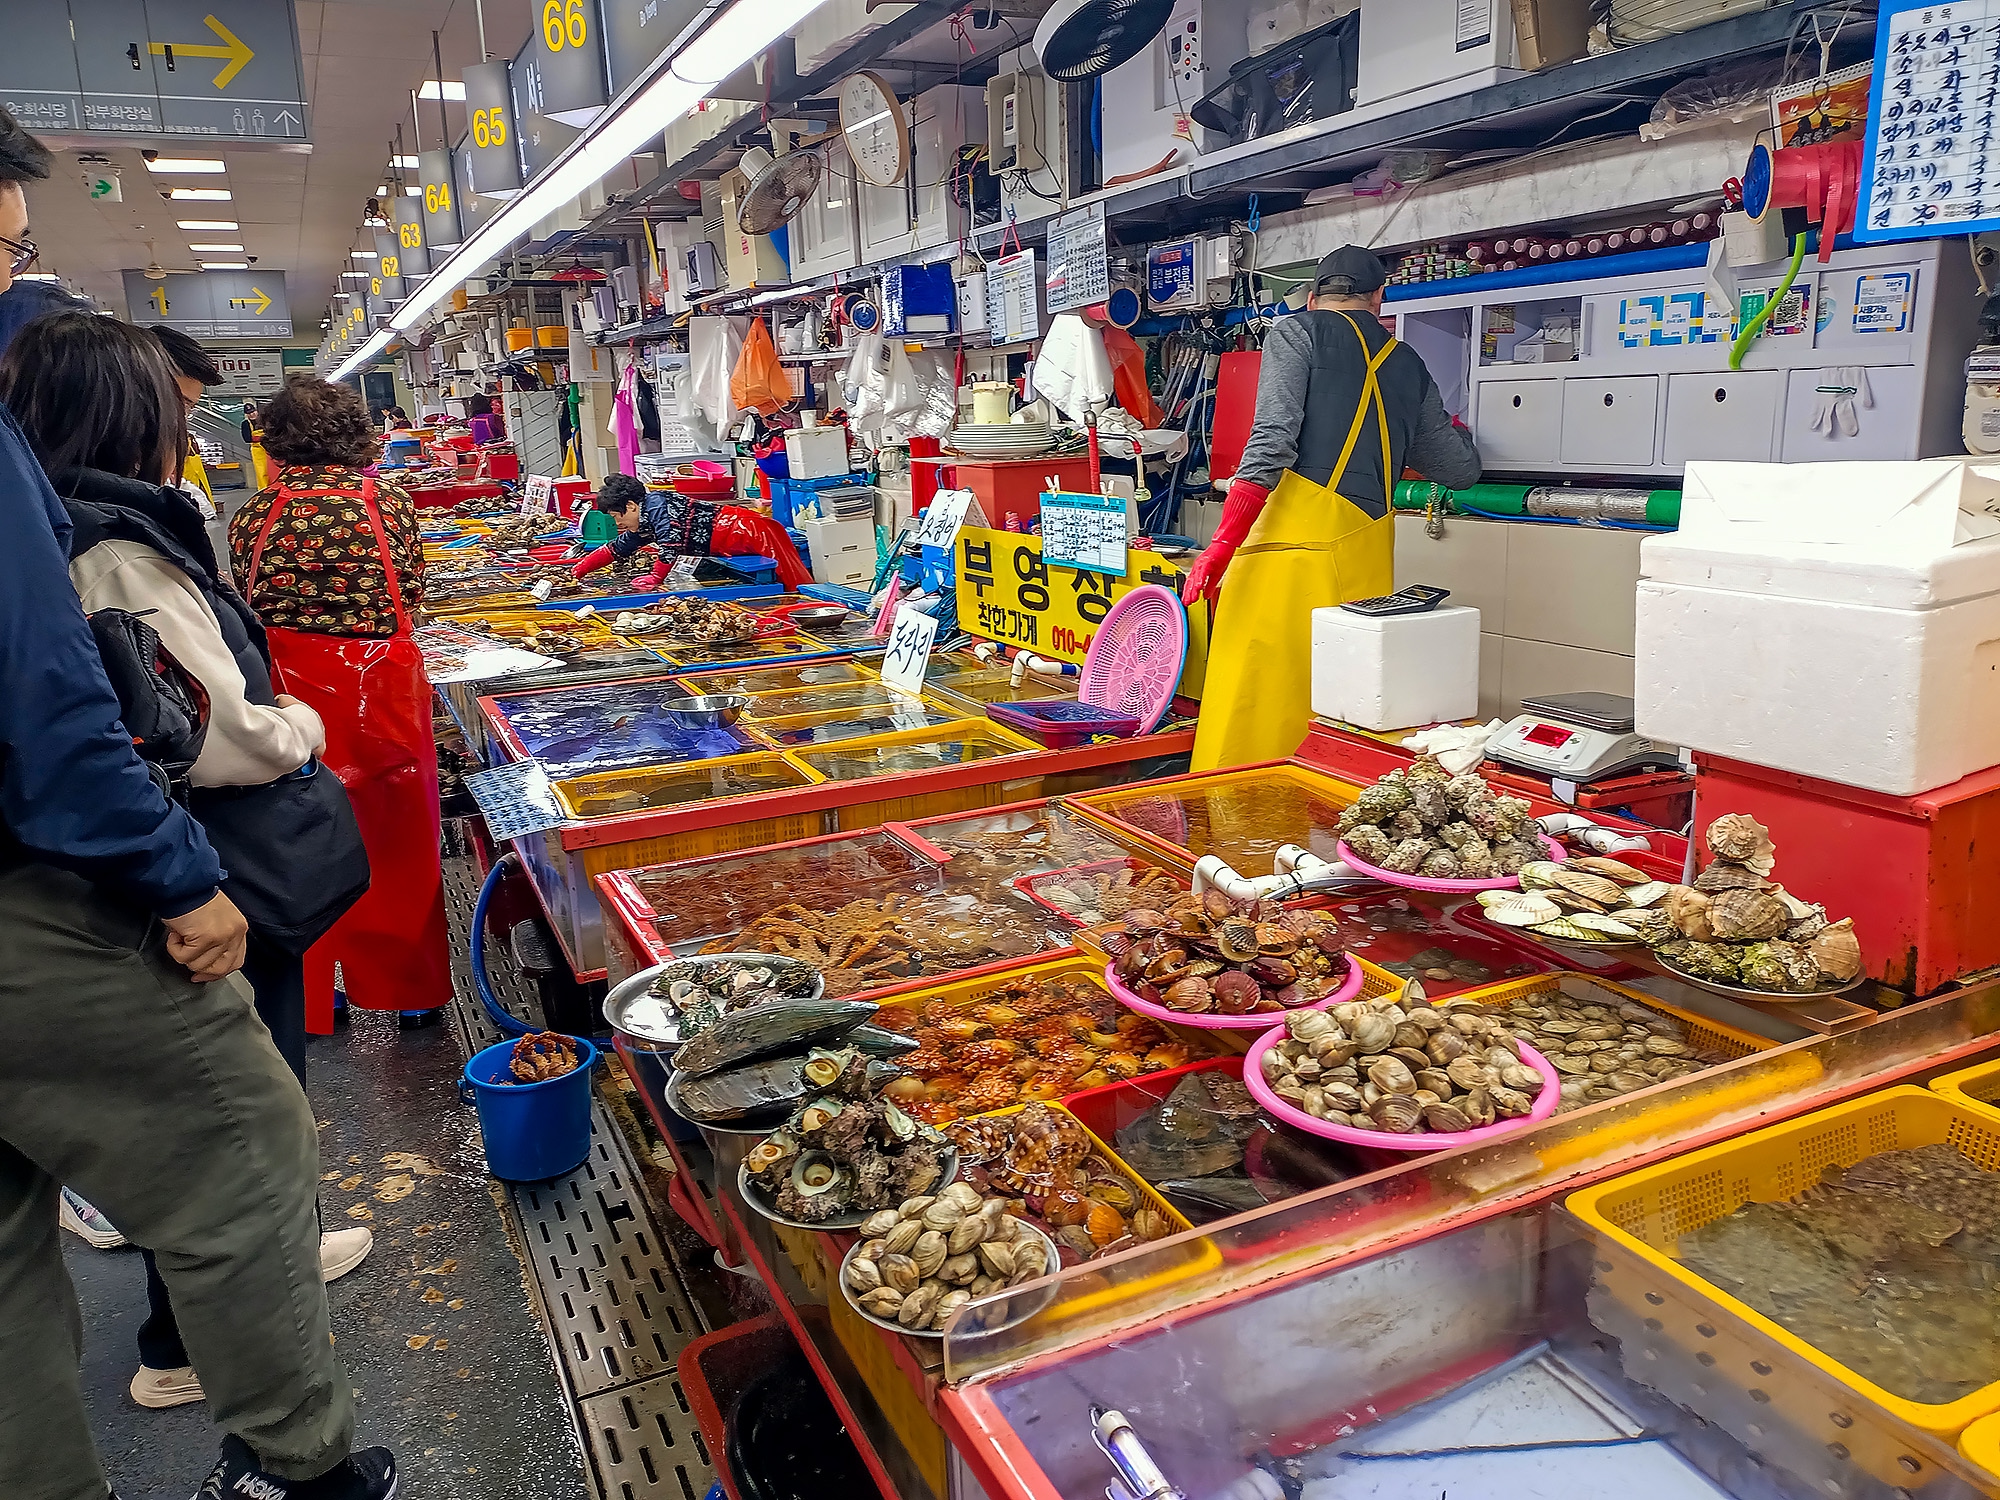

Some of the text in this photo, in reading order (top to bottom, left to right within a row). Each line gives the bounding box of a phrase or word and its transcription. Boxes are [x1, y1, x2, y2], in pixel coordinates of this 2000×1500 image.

[542, 0, 587, 52] 66
[83, 104, 153, 121] 외부화장실
[472, 107, 507, 148] 65
[425, 183, 450, 214] 64
[400, 223, 421, 249] 63
[381, 256, 399, 277] 62
[151, 286, 168, 316] 1
[352, 307, 365, 322] 10
[917, 514, 958, 547] 오징어
[887, 620, 934, 677] 도다리
[233, 1471, 287, 1500] HOKA
